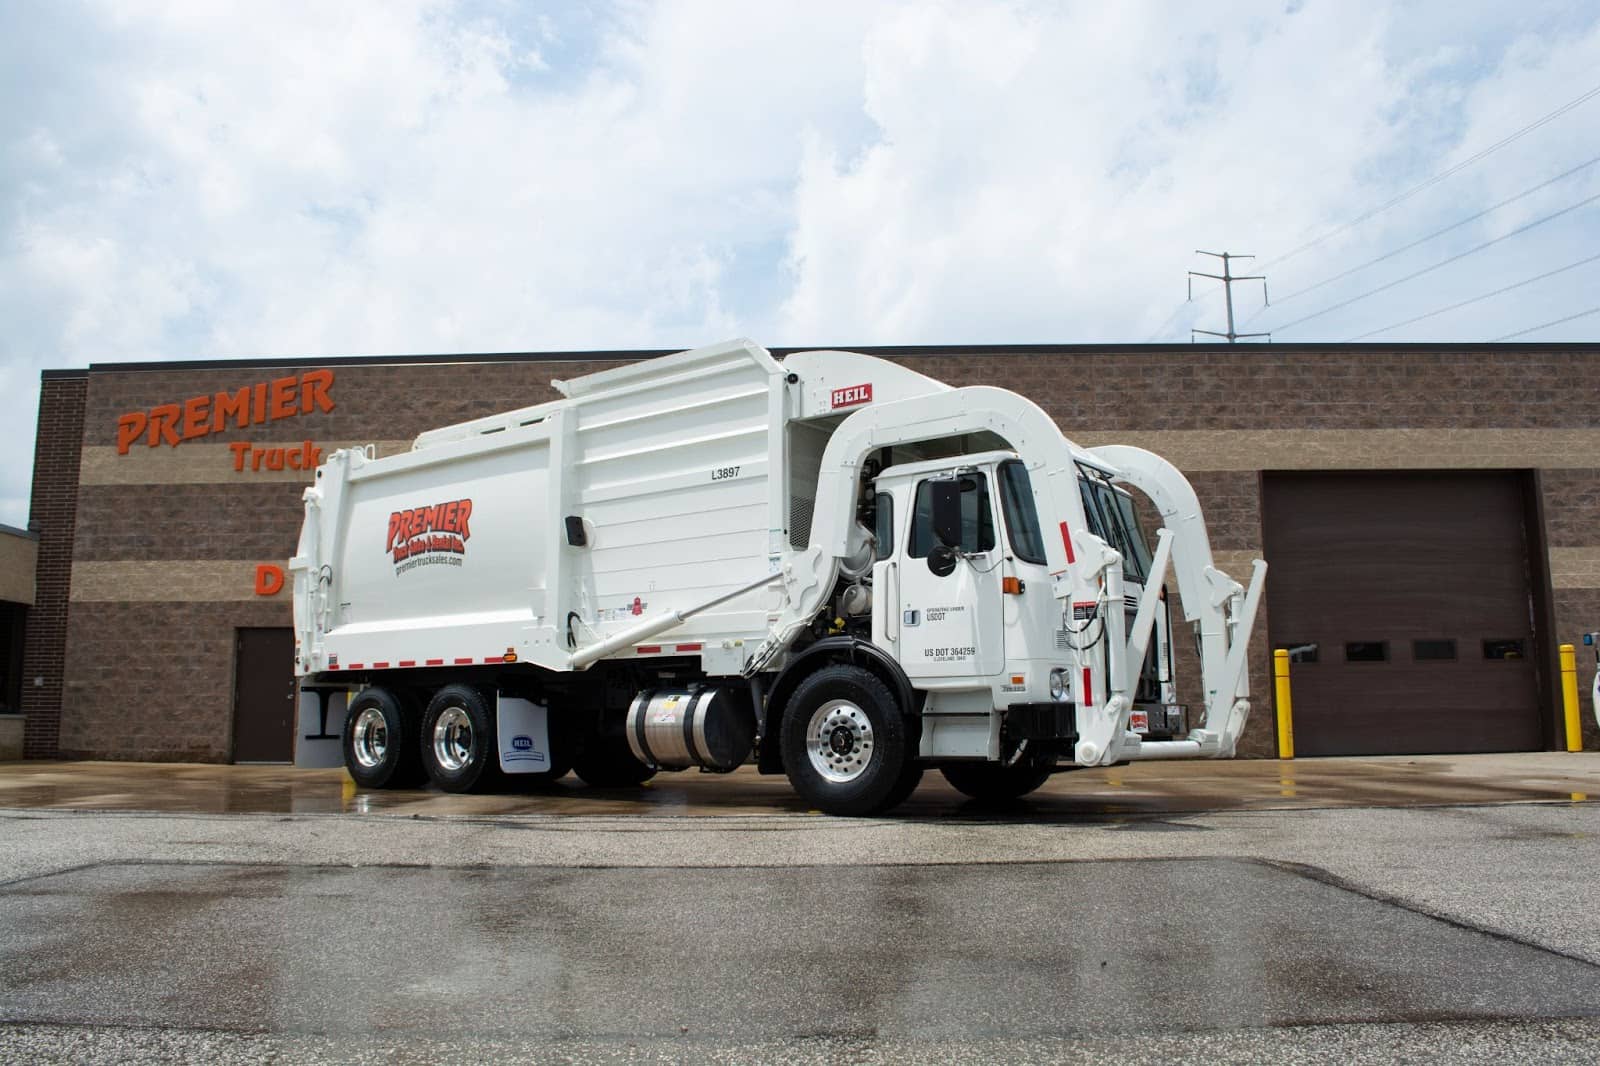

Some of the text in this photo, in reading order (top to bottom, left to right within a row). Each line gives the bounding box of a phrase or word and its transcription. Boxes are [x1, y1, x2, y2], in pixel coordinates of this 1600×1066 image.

[833, 386, 868, 405] HEIL
[117, 368, 336, 455] PREMIER
[230, 440, 322, 472] Truck
[711, 466, 740, 480] L3897
[385, 498, 473, 553] PREMIER
[396, 555, 463, 576] premiertrucksales.com
[255, 564, 284, 596] D
[924, 647, 976, 657] US DOT 364259
